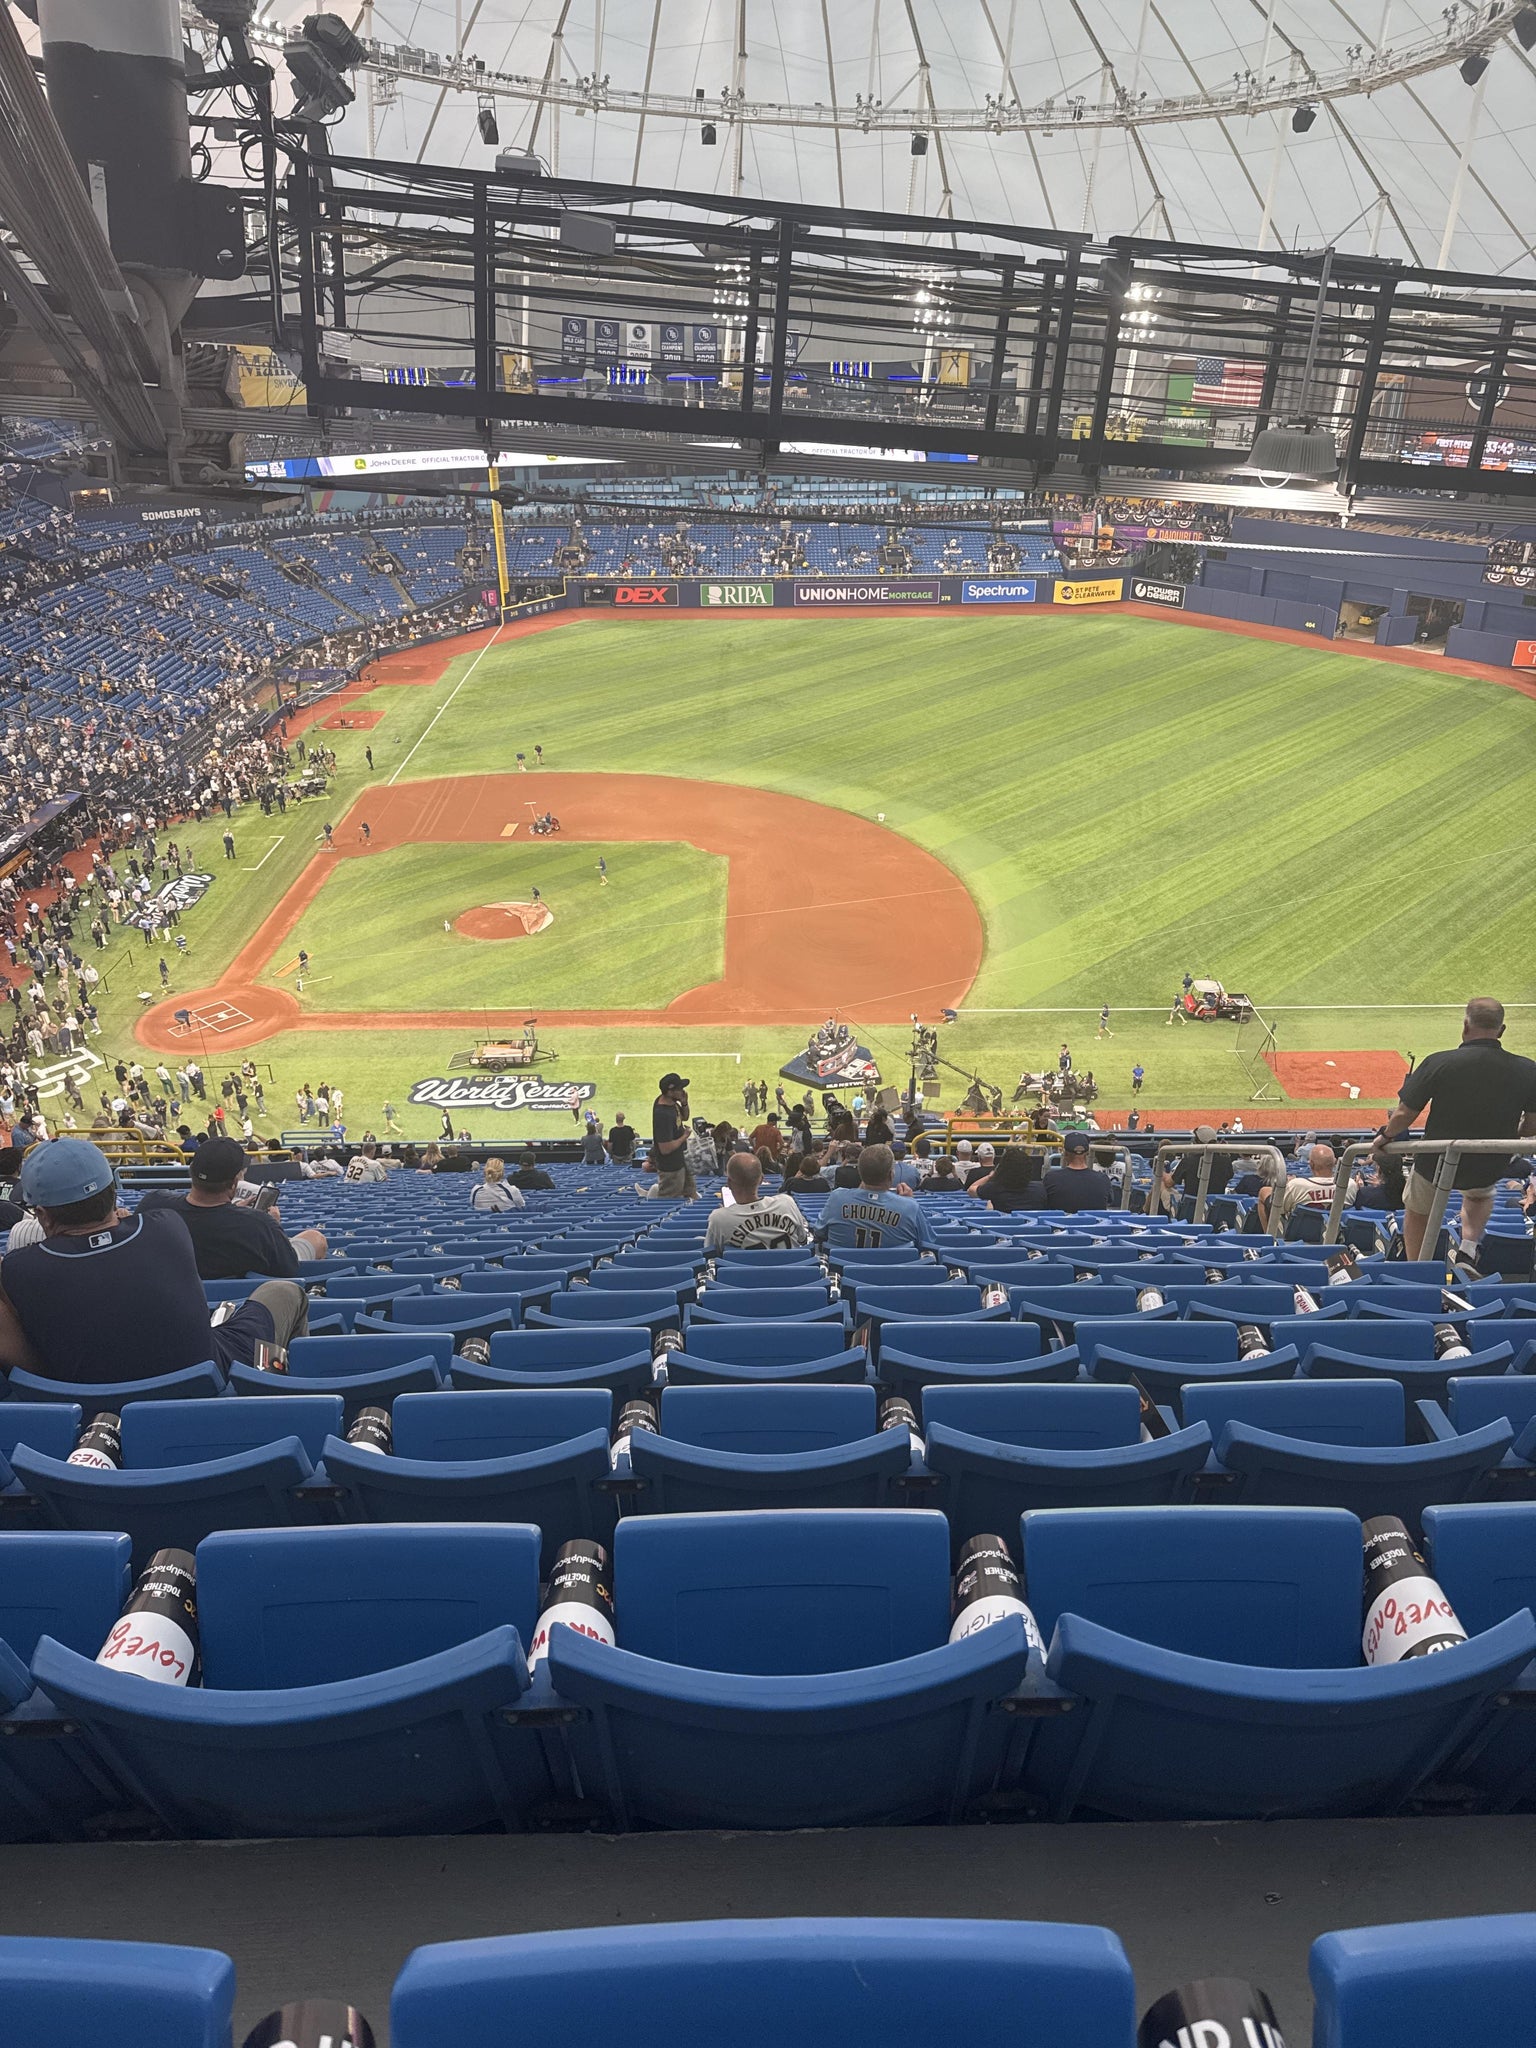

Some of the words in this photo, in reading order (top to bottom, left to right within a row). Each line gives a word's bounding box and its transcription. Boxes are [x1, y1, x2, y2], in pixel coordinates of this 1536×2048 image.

[370, 459, 390, 467] JOHN
[391, 458, 417, 466] DEERE
[450, 455, 480, 463] TRACTOR
[141, 510, 176, 521] SOMOS
[176, 507, 202, 518] RAYS
[615, 586, 669, 603] DEX
[724, 585, 768, 604] RIPA
[968, 585, 1026, 599] Spectrum
[1074, 590, 1116, 599] CLEARWATER
[414, 1080, 516, 1101] World
[495, 1081, 591, 1109] Series
[842, 1204, 901, 1227] CHOURIO
[855, 1227, 882, 1249] 11
[1369, 1547, 1408, 1570] TOGETHER
[554, 1572, 591, 1585] TOGETHER
[142, 1582, 182, 1598] TOGETHER
[104, 1638, 185, 1679] LOVED
